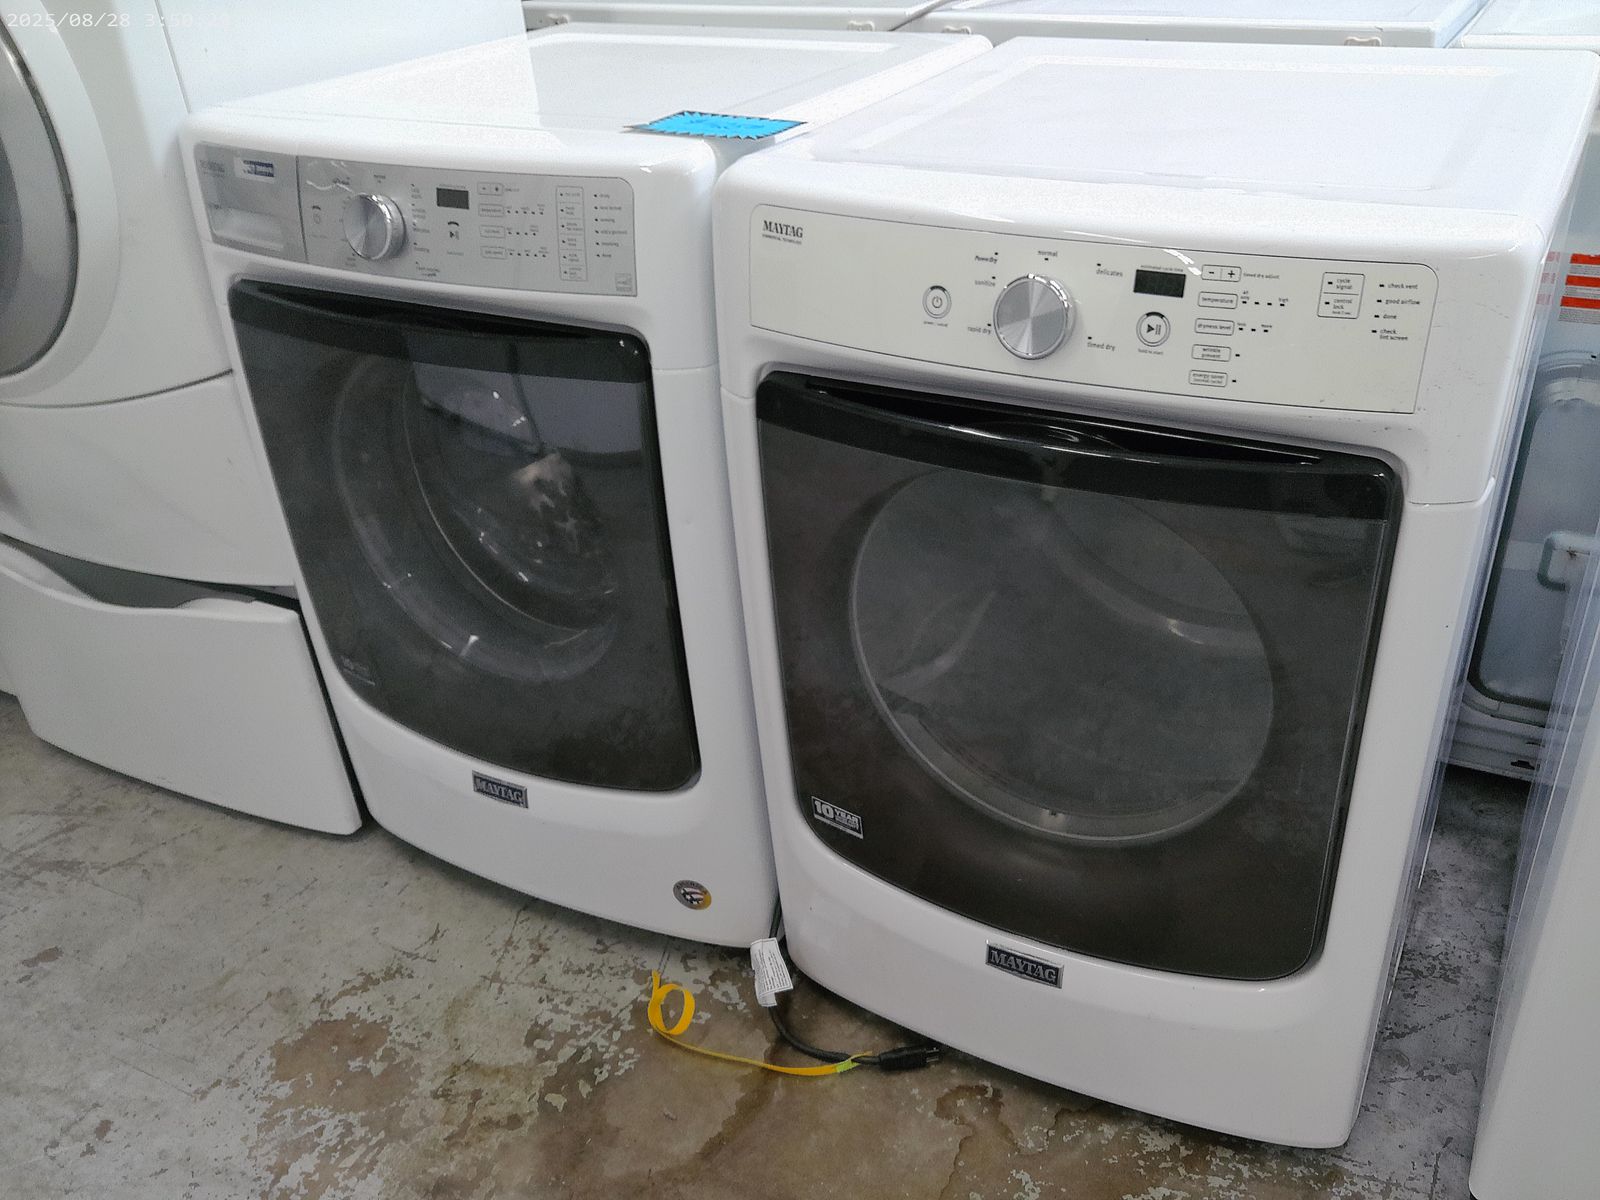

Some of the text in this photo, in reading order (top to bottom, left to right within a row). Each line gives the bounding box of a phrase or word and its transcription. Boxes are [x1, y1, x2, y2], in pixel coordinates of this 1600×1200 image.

[762, 220, 803, 239] MAYTAG
[1096, 268, 1123, 277] delicates
[1087, 341, 1116, 352] timed dry
[475, 776, 523, 803] MAYTAG
[814, 800, 859, 823] 10 YEAR
[990, 950, 1057, 983] MAYTAG
